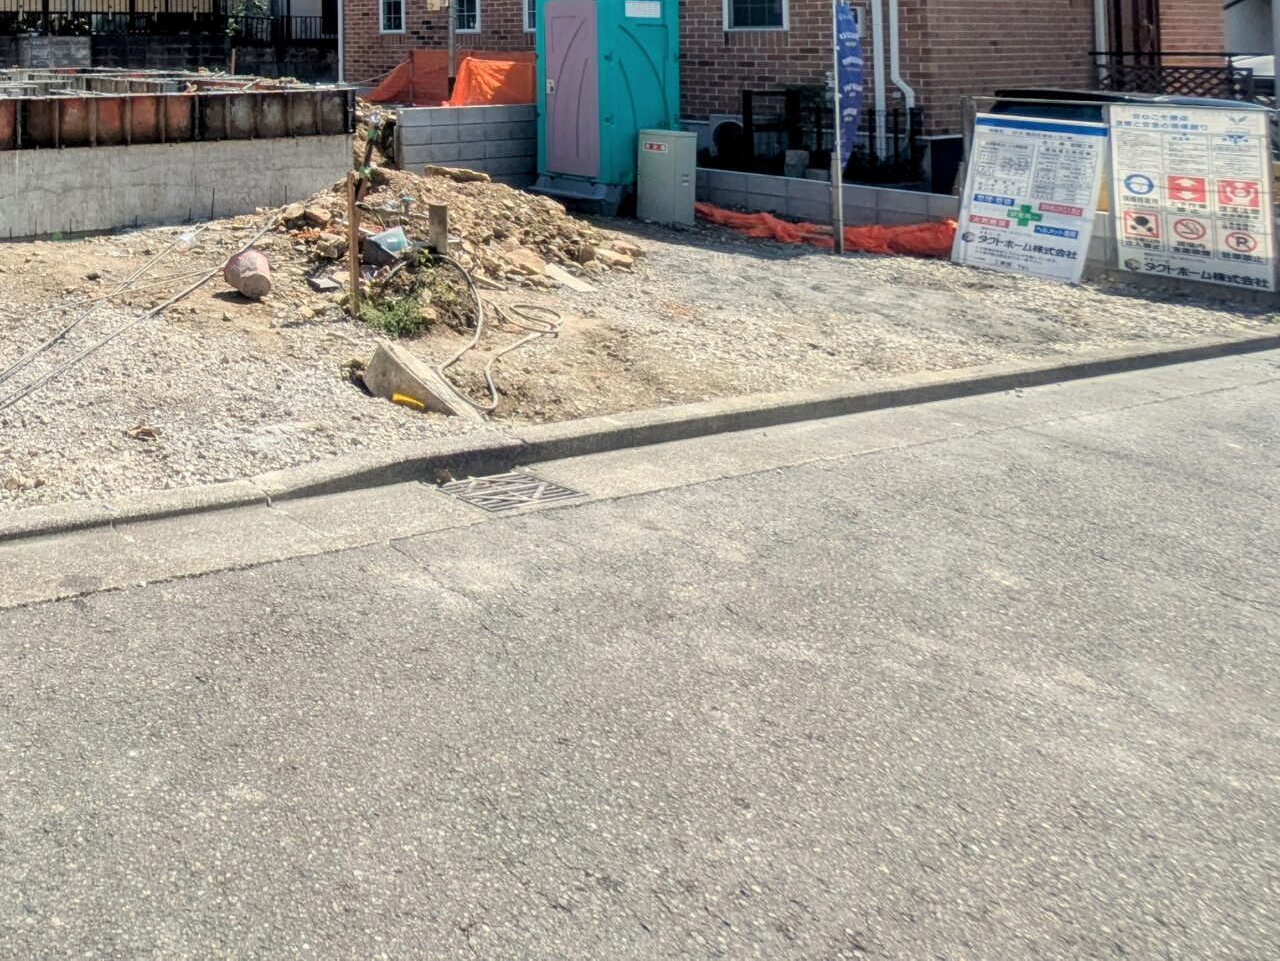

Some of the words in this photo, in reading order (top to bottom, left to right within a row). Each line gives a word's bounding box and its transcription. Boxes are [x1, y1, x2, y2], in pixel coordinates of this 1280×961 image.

[977, 235, 1078, 260] タクトホーム株式会社
[1144, 262, 1269, 288] タクトホーム株式会社
